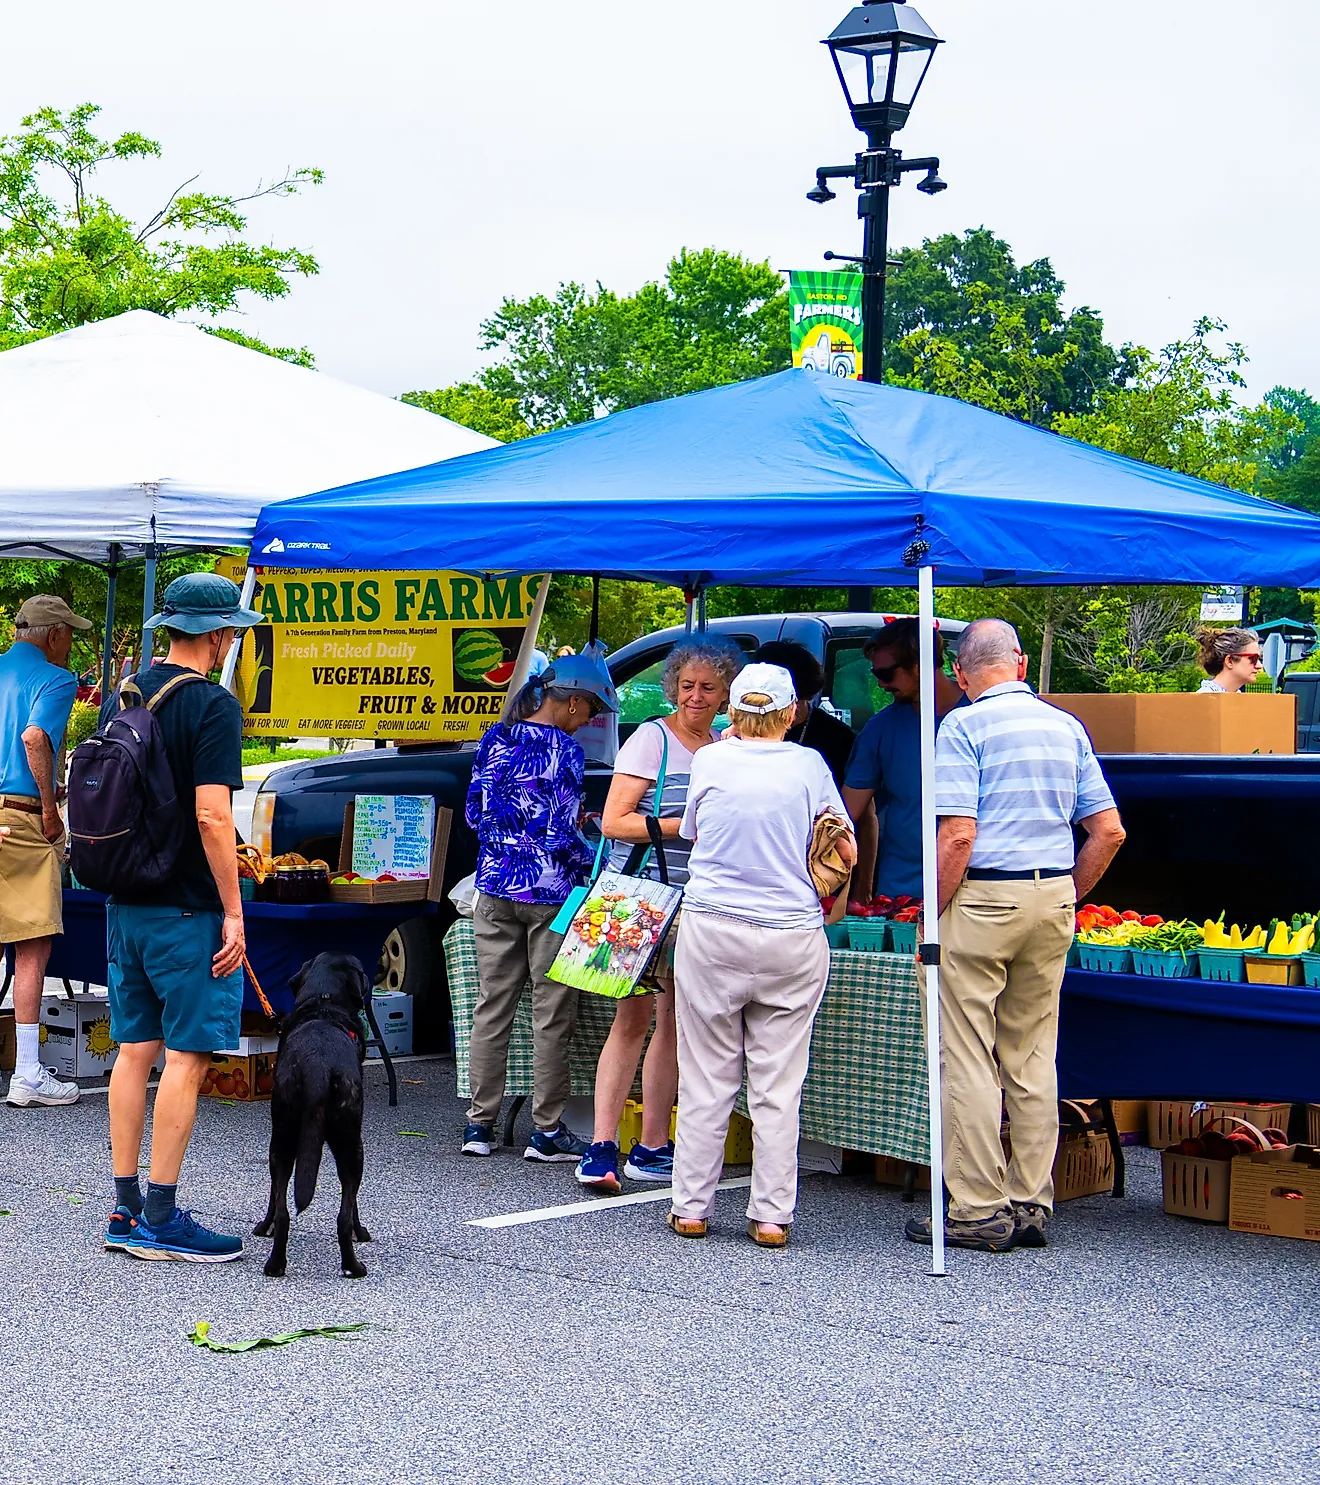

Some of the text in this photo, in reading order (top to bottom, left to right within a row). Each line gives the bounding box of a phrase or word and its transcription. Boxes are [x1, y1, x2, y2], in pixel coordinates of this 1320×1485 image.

[794, 304, 861, 326] FARMERS
[311, 542, 331, 550] TRAIL
[250, 580, 381, 623] ARRIS
[300, 628, 331, 636] Generation
[331, 628, 351, 637] Family
[352, 628, 367, 636] Farm
[368, 628, 382, 636] from
[383, 628, 408, 636] Preston,
[408, 627, 438, 636] Maryland
[281, 641, 417, 662] Fresh Picked Daily
[312, 666, 435, 688] VEGETABLES,
[358, 695, 417, 714] FRUIT
[421, 695, 437, 714] &
[257, 718, 271, 728] FOR
[272, 718, 290, 729] YOU!
[298, 718, 312, 729] EAT
[312, 719, 334, 730] MORE
[334, 719, 367, 730] VEGGIES!
[377, 720, 406, 731] GROWN
[406, 720, 431, 731] LOCAL!
[442, 720, 470, 732] FRESH!
[135, 1224, 158, 1242] HOKA
[1232, 1220, 1252, 1229] PRODUCE
